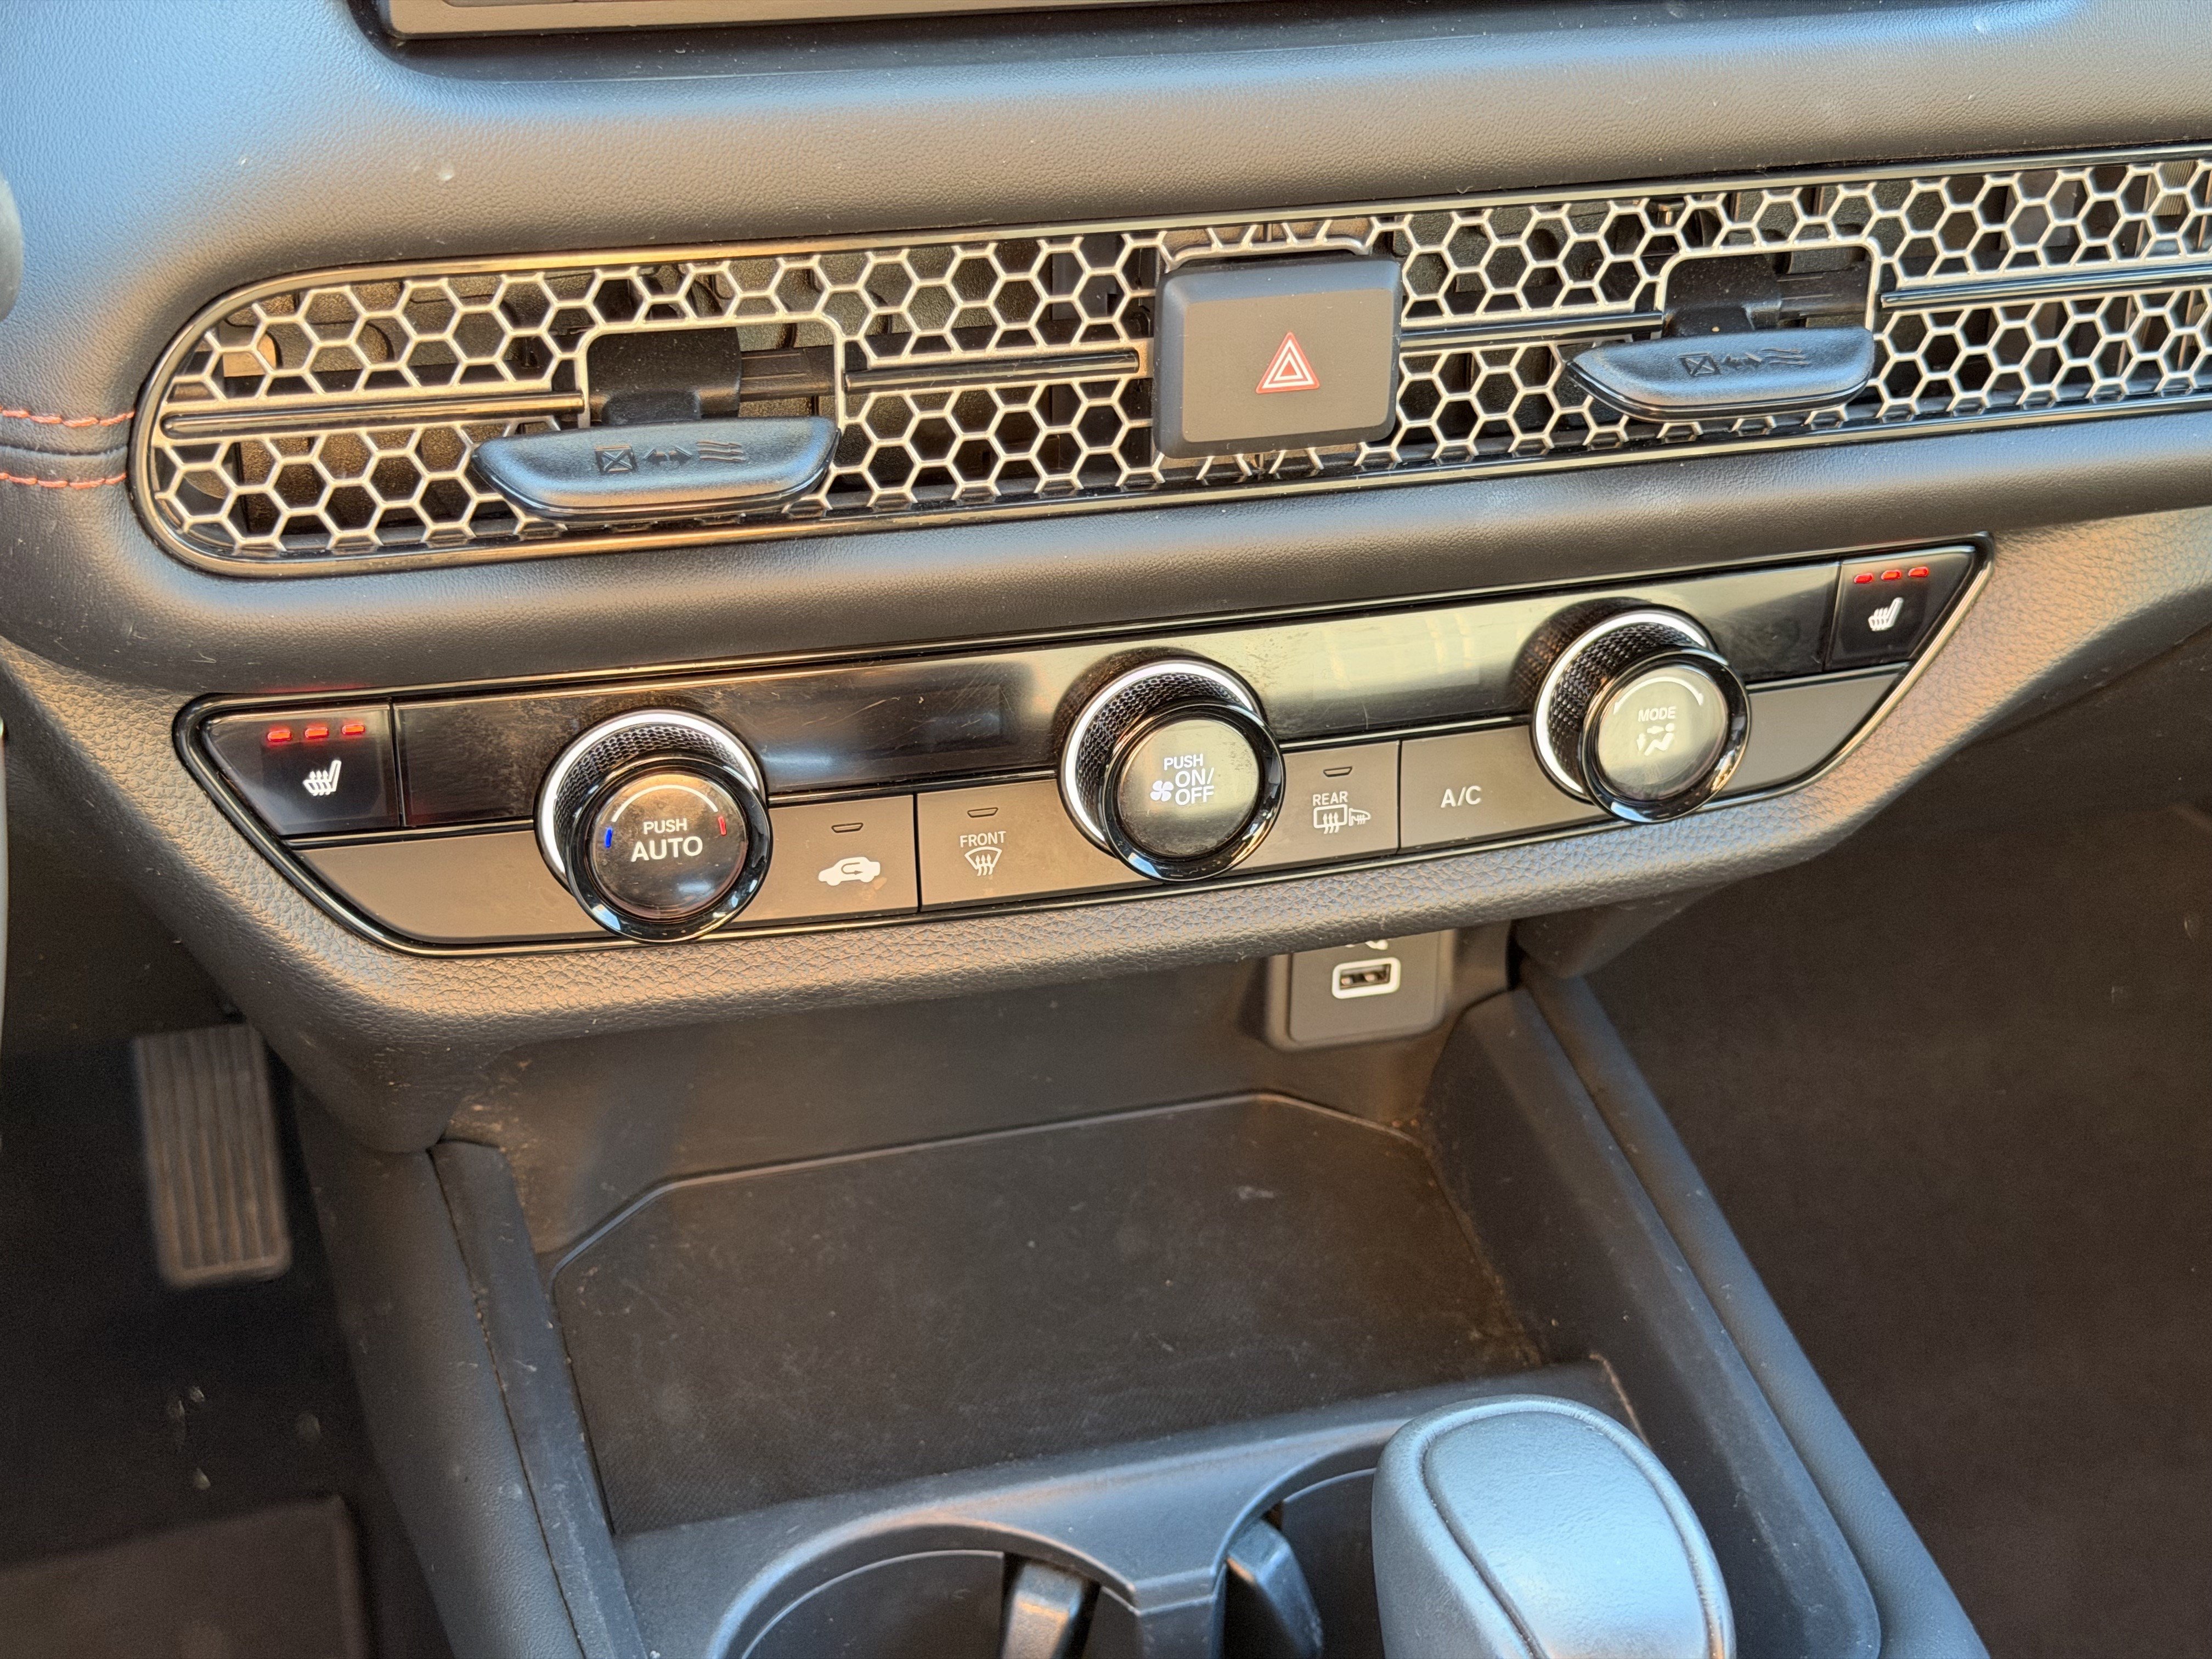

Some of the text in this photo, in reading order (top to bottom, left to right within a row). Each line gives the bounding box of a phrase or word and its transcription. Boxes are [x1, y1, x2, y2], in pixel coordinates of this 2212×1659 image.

[1638, 706, 1676, 721] MODE
[1164, 753, 1203, 770] PUSH
[1175, 768, 1215, 787] ON/
[1175, 785, 1214, 805] OFF
[1312, 791, 1348, 806] REAR
[1441, 786, 1481, 808] A/C
[643, 818, 687, 834] PUSH
[960, 831, 1006, 848] FRONT
[631, 836, 703, 862] AUTO
